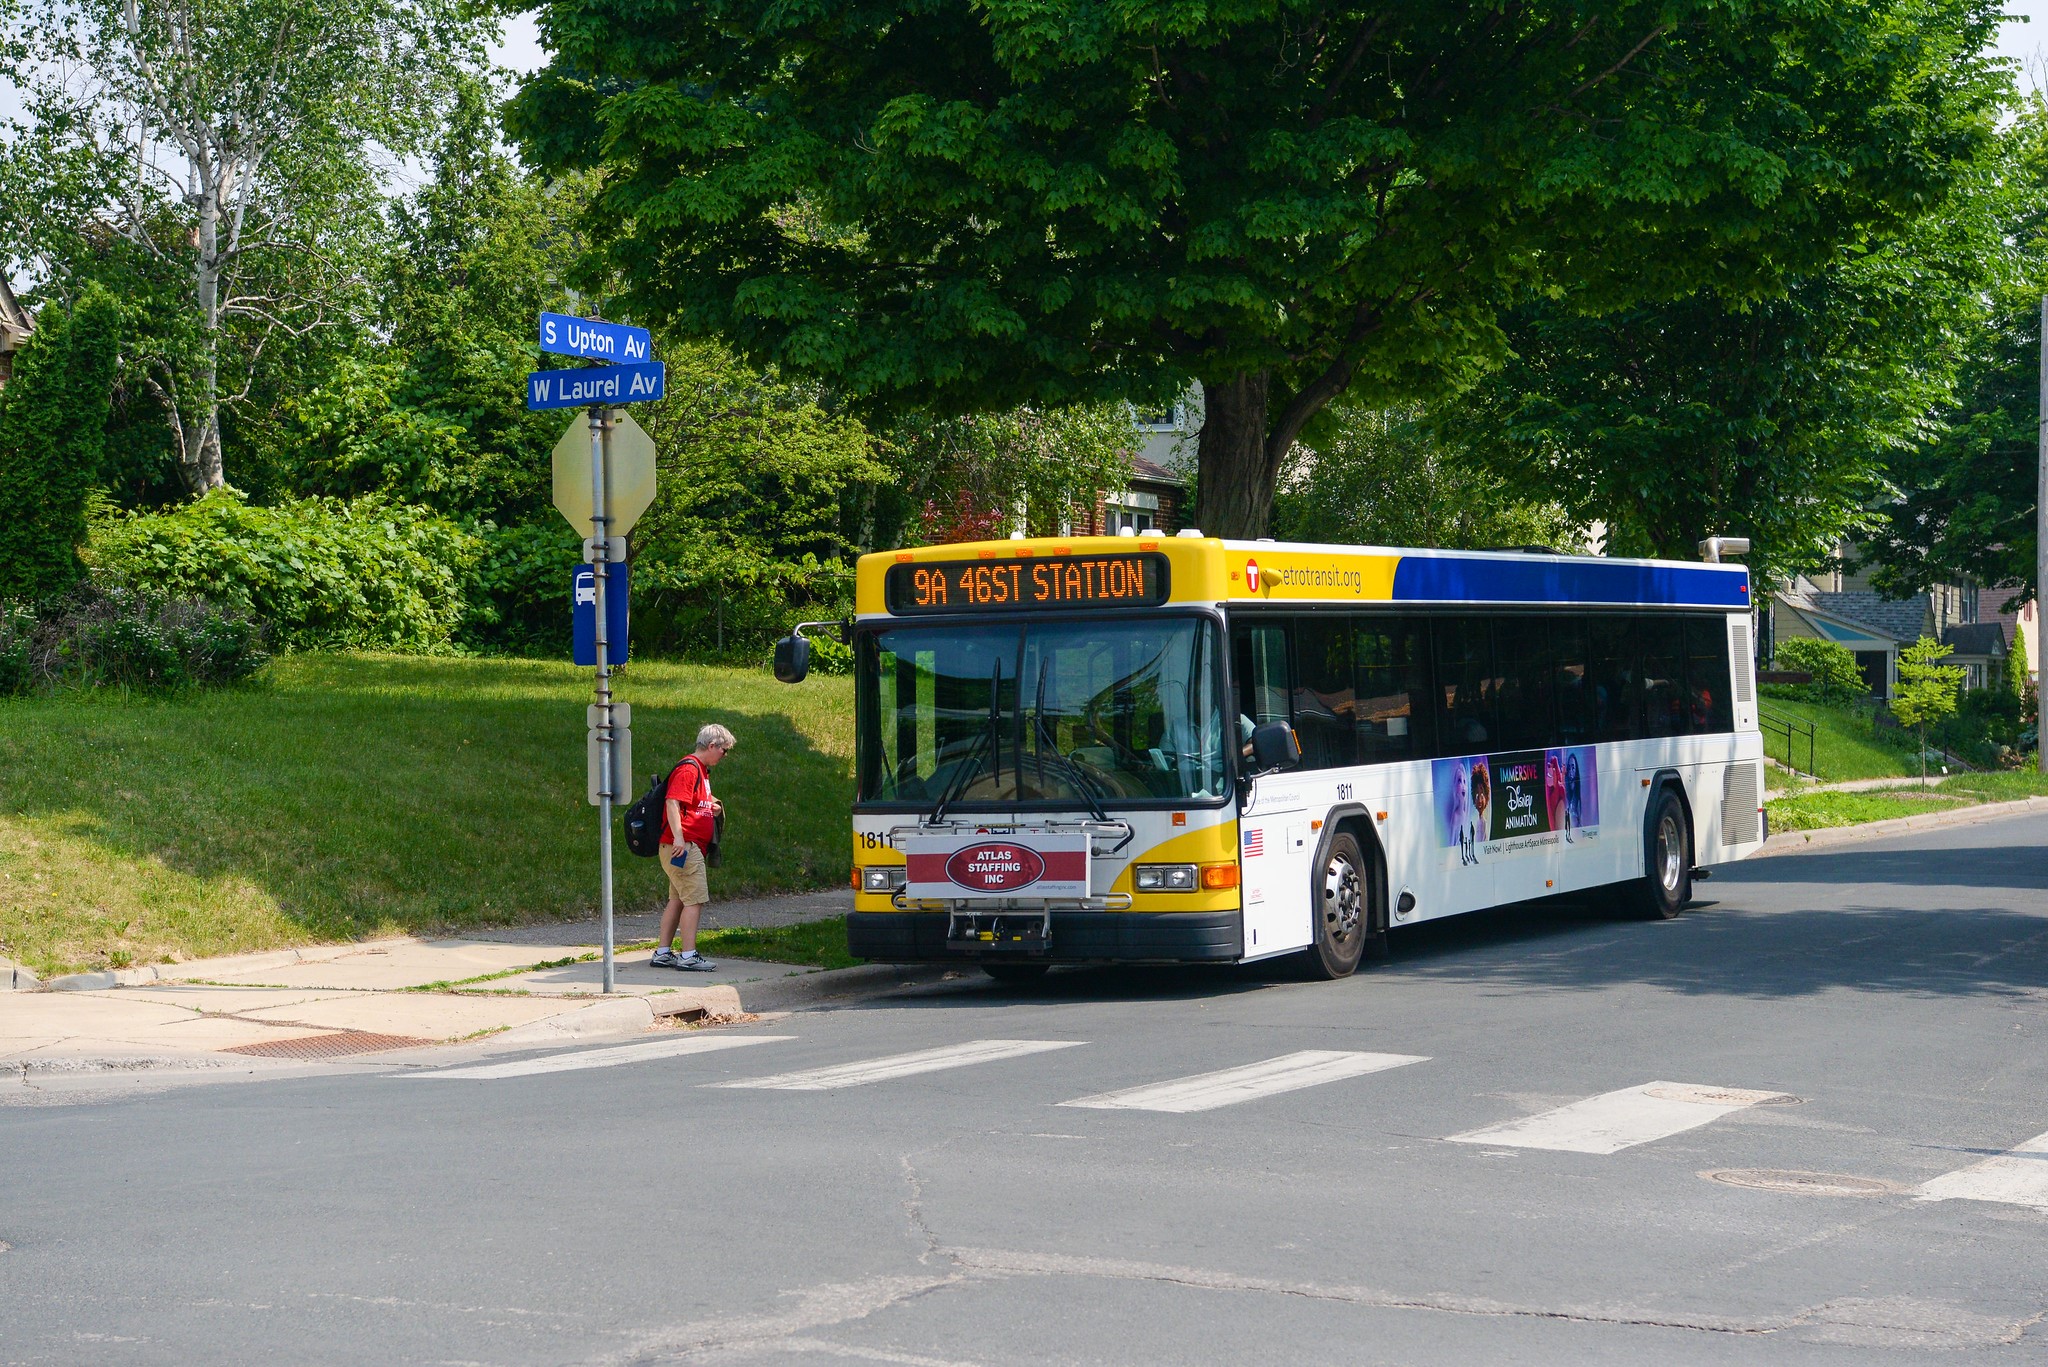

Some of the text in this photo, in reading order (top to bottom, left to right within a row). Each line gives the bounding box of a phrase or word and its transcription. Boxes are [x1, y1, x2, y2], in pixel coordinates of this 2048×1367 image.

[545, 321, 646, 359] S Upton Av
[533, 372, 657, 402] W Laurel Av
[913, 559, 1144, 605] 9A 46ST STATION
[1500, 764, 1538, 783] IMMERSIVE
[1336, 782, 1353, 801] 1811
[1506, 785, 1533, 818] Disney
[1505, 813, 1538, 830] ANIMATION
[976, 850, 1012, 861] ATLAS
[967, 862, 1021, 873] STAFFING
[984, 874, 1004, 884] INC
